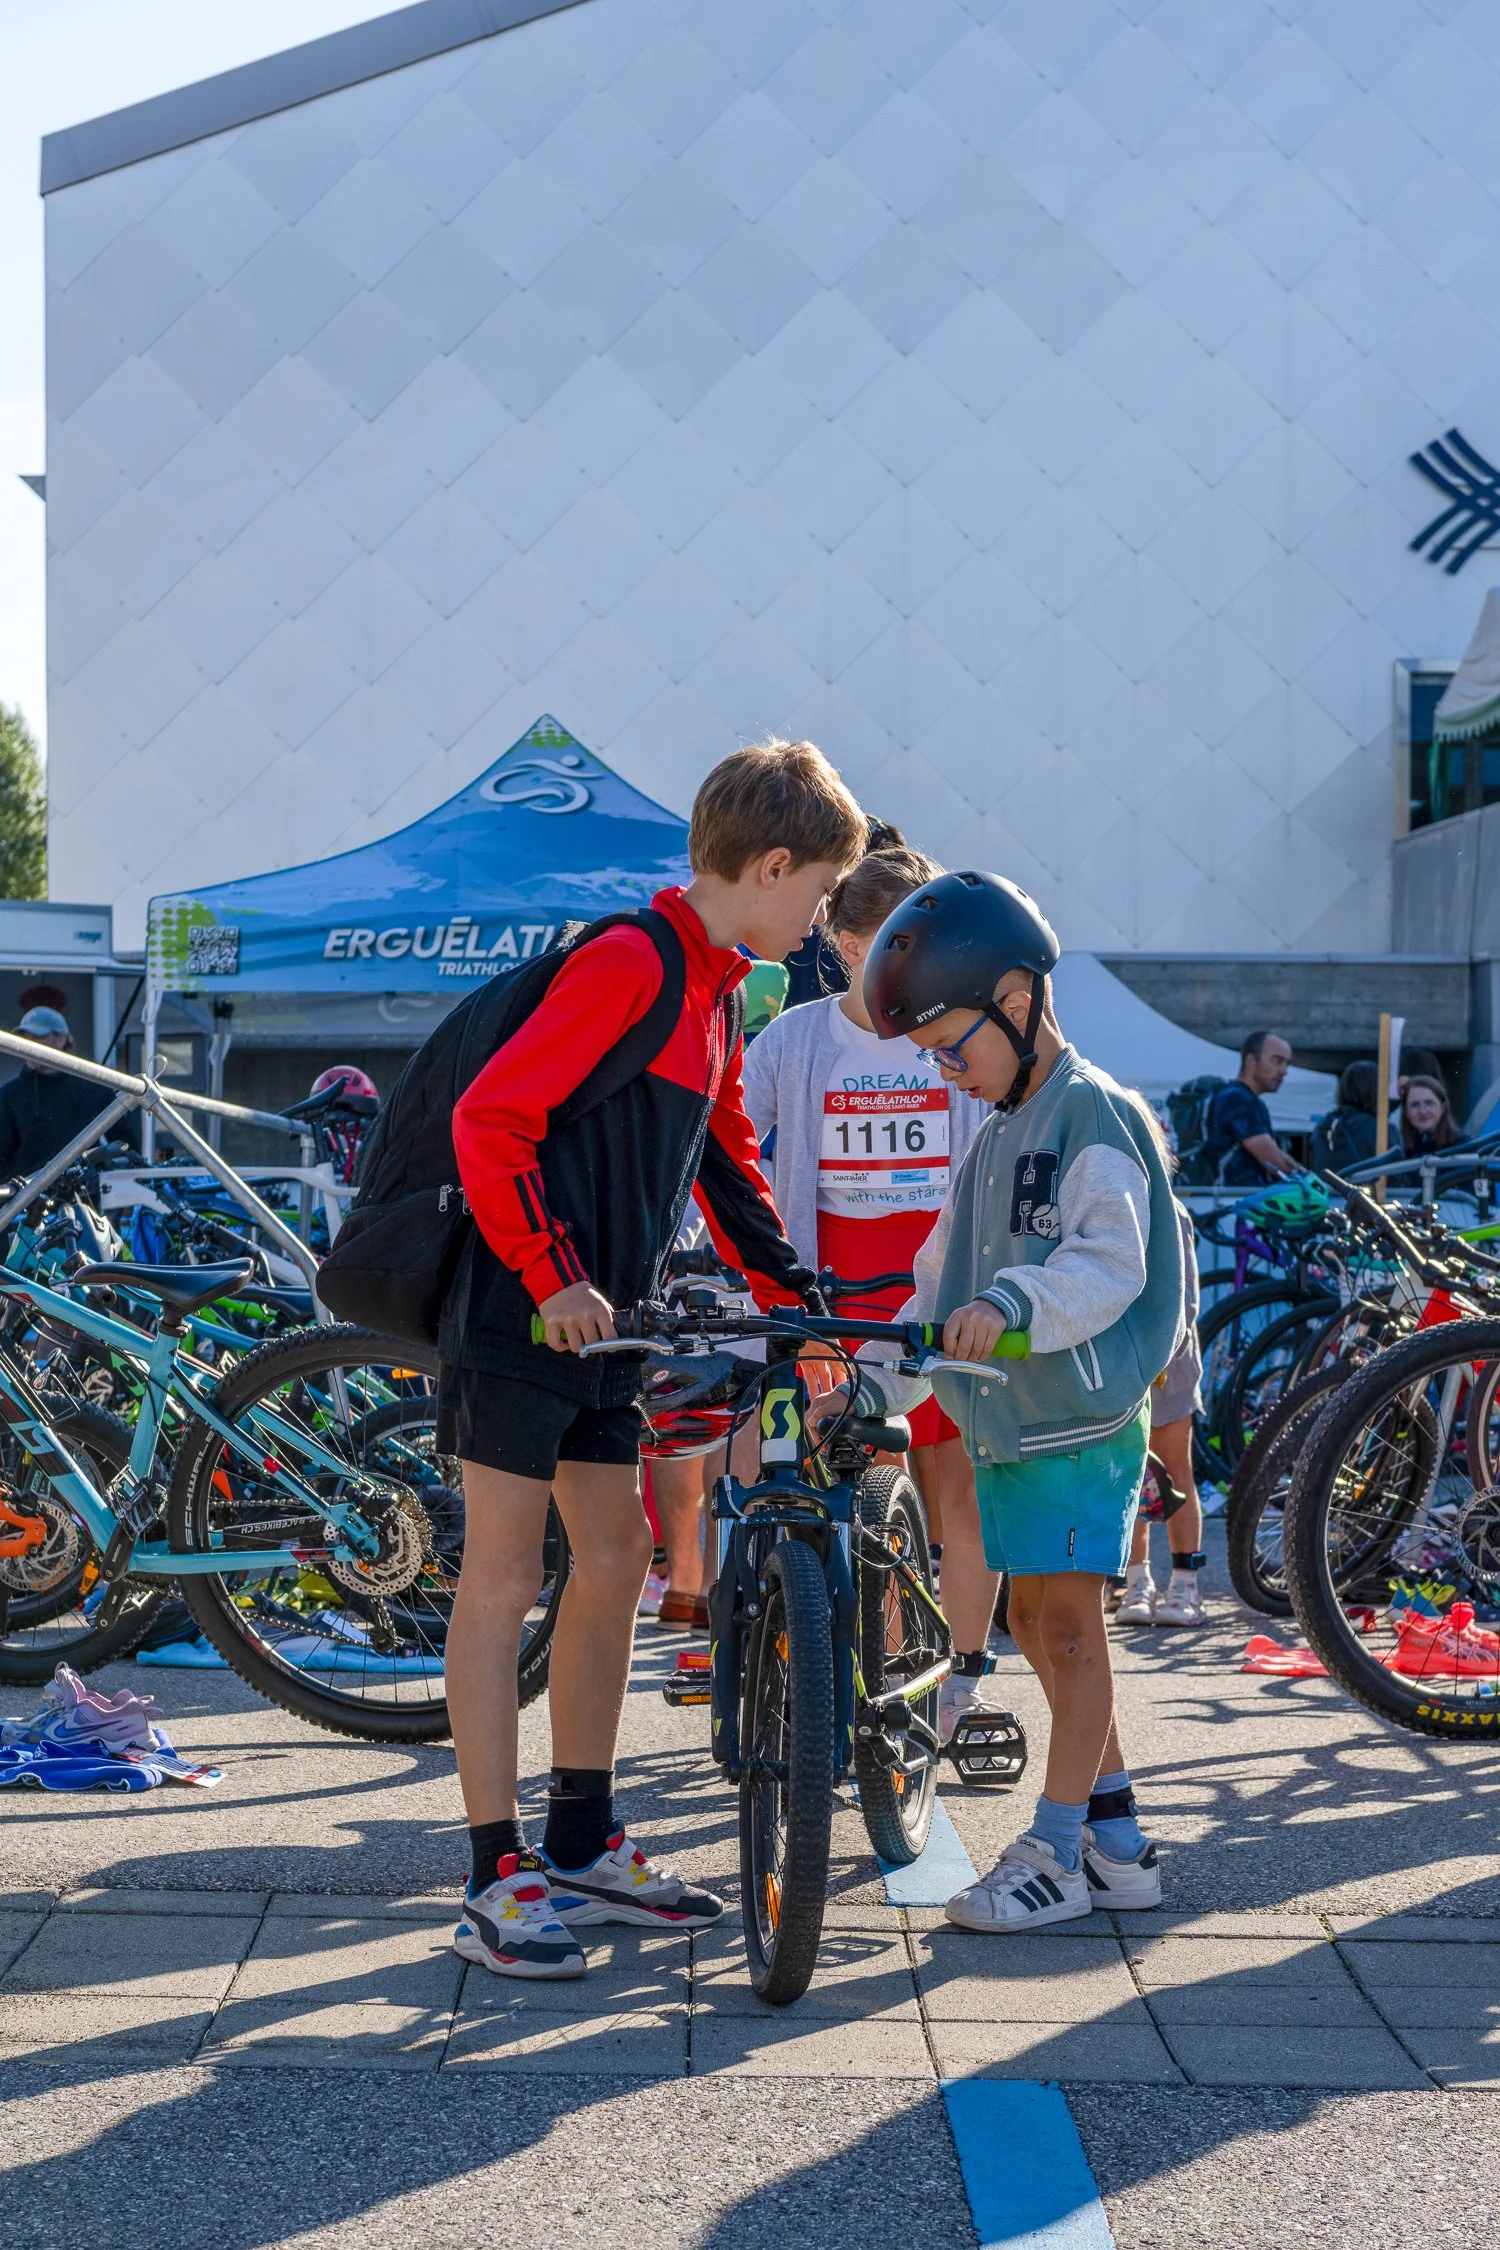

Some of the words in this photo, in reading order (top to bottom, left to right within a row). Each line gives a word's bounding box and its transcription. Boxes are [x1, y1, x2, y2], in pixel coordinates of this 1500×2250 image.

[438, 961, 525, 976] TRIATHLO
[916, 1002, 946, 1023] BTWIN
[842, 1073, 929, 1092] DREAM
[835, 1119, 926, 1153] 1116
[832, 1174, 868, 1182] SAINT-IMIER
[845, 1191, 875, 1204] with
[877, 1192, 904, 1204] the
[908, 1185, 947, 1201] stars
[1010, 1148, 1061, 1237] H
[1038, 1219, 1052, 1229] 63
